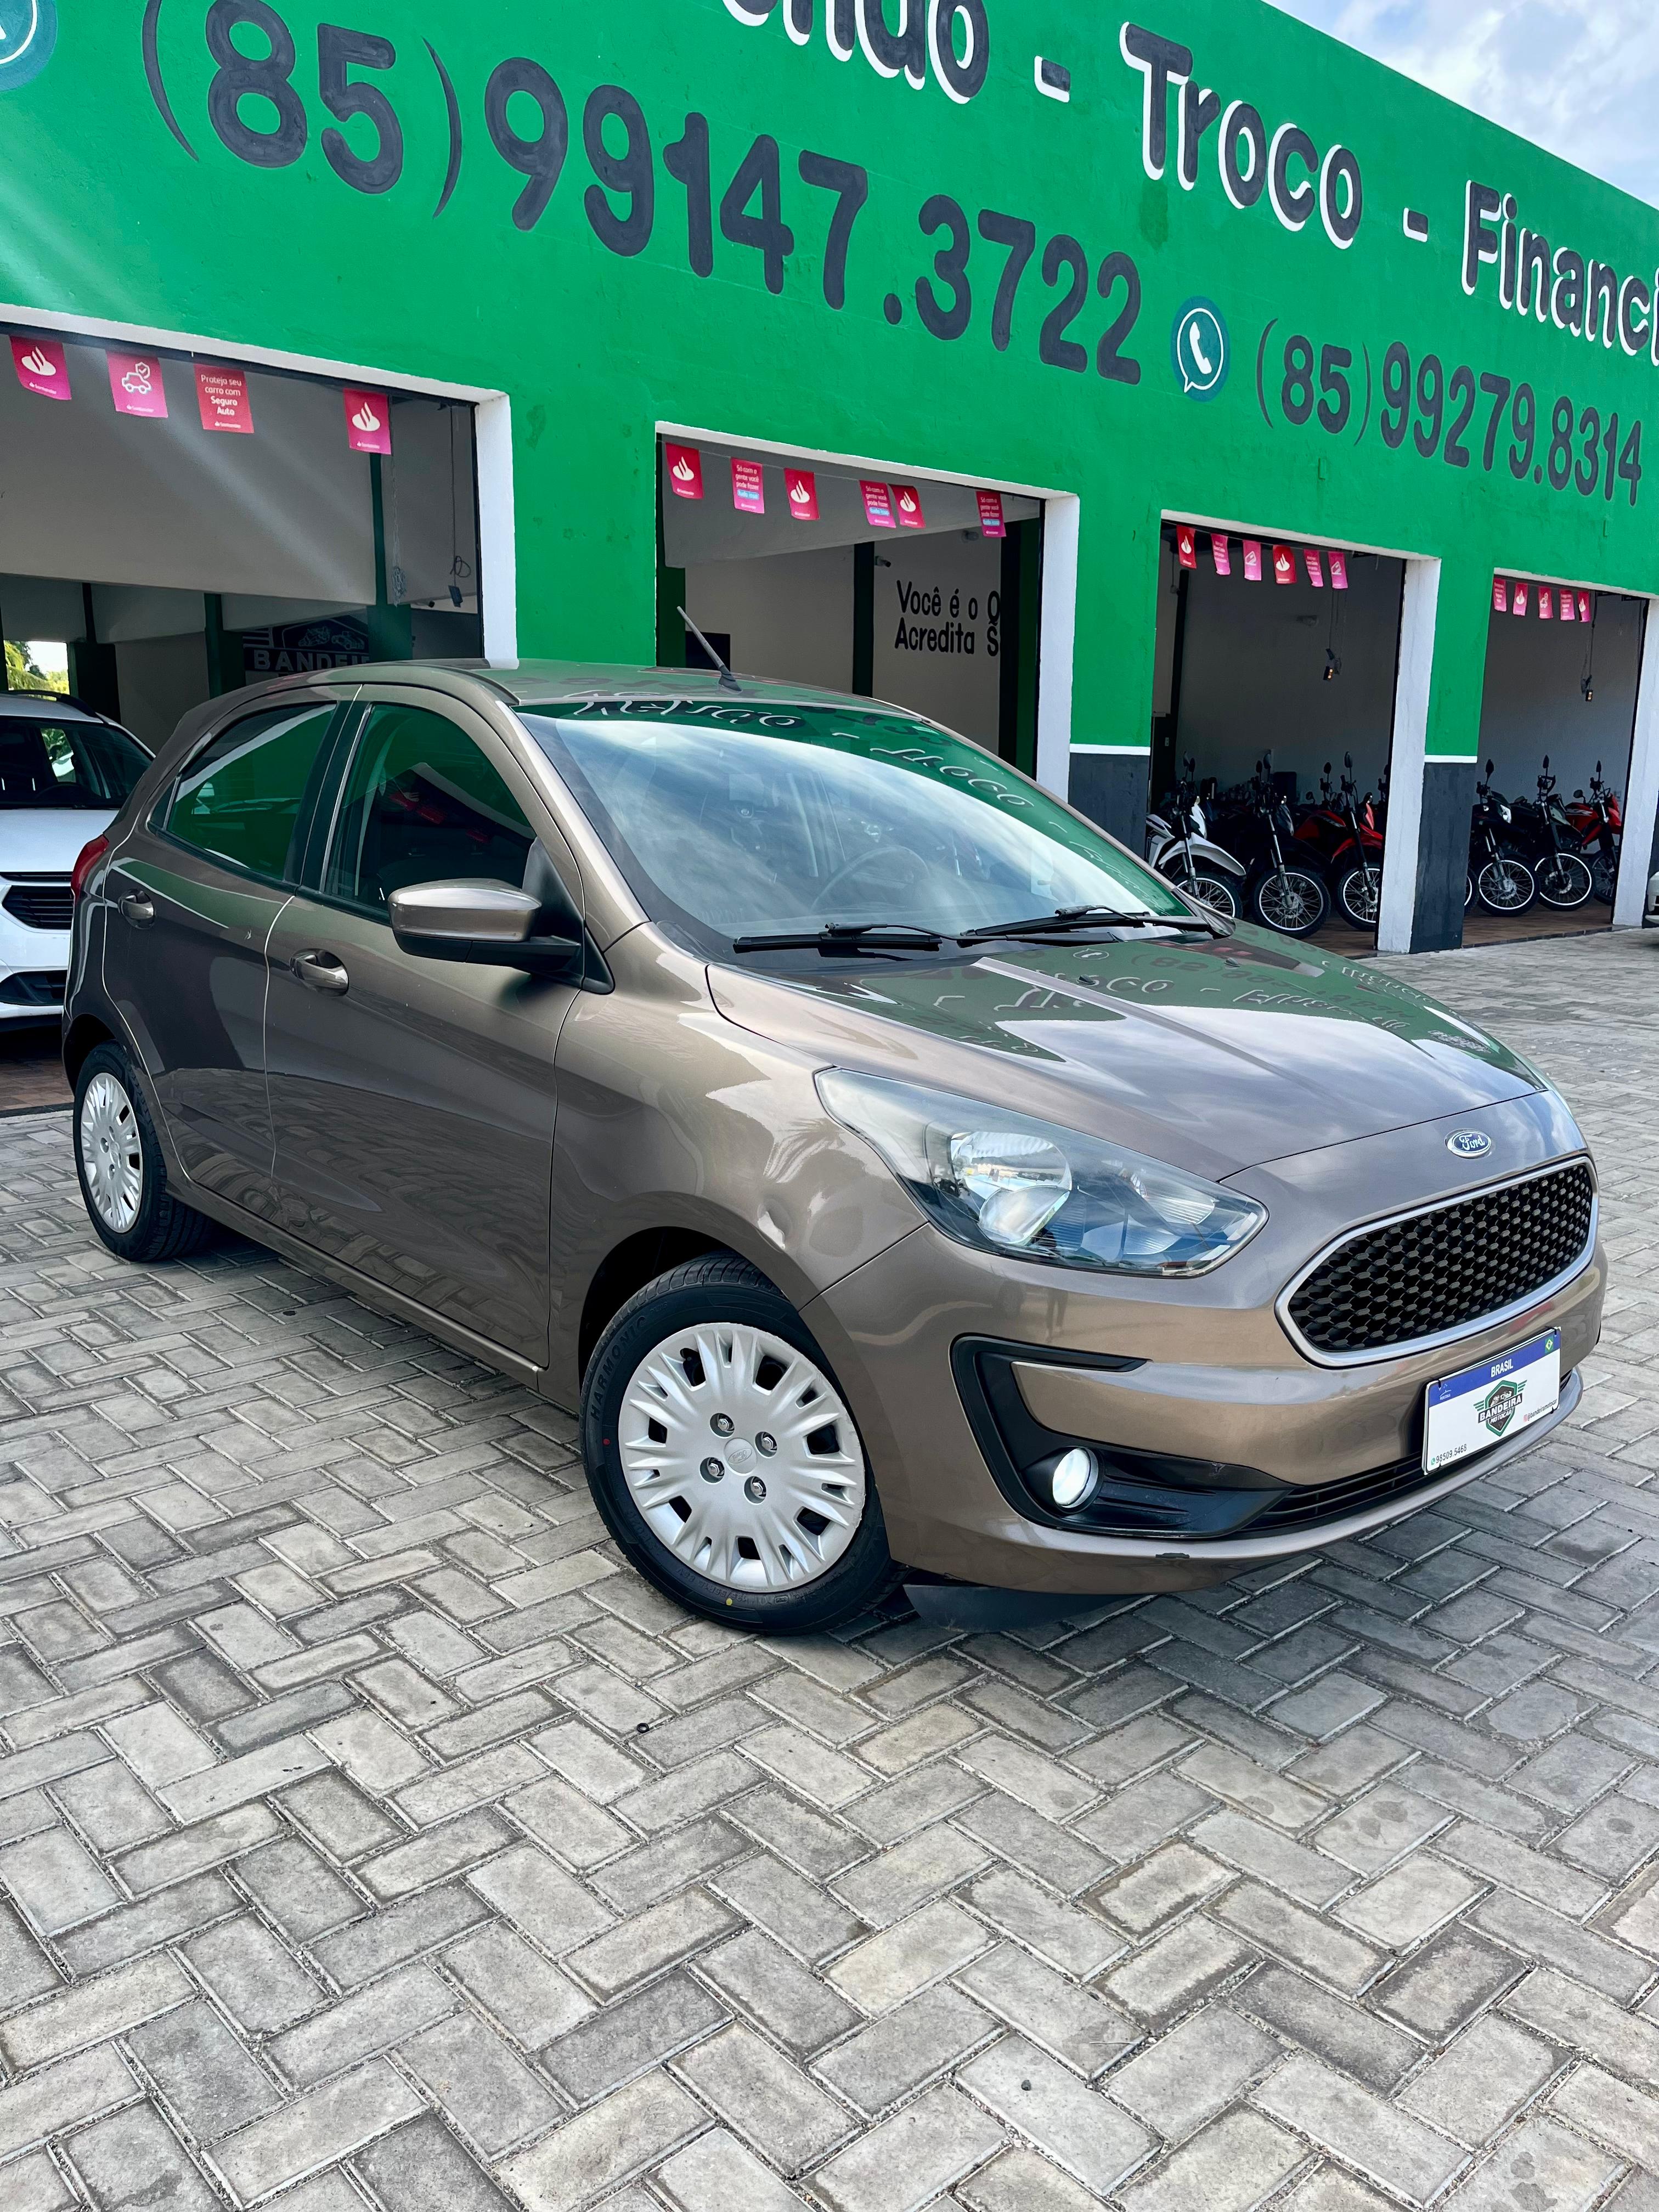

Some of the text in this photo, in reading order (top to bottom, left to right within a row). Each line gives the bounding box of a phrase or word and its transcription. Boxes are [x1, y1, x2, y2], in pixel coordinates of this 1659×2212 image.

[1119, 21, 1362, 250] Troco
[201, 374, 228, 386] Proteja
[210, 396, 238, 407] Seguro
[217, 406, 235, 416] Auto
[896, 580, 941, 616] Você
[950, 589, 960, 618] é
[969, 597, 978, 620] o
[894, 617, 974, 654] Acredita
[1459, 1134, 1485, 1150] Ford
[1491, 1358, 1514, 1378] BRASIL
[1480, 1395, 1522, 1421] BANDEIRA
[1436, 1444, 1467, 1463] 98509.5468
